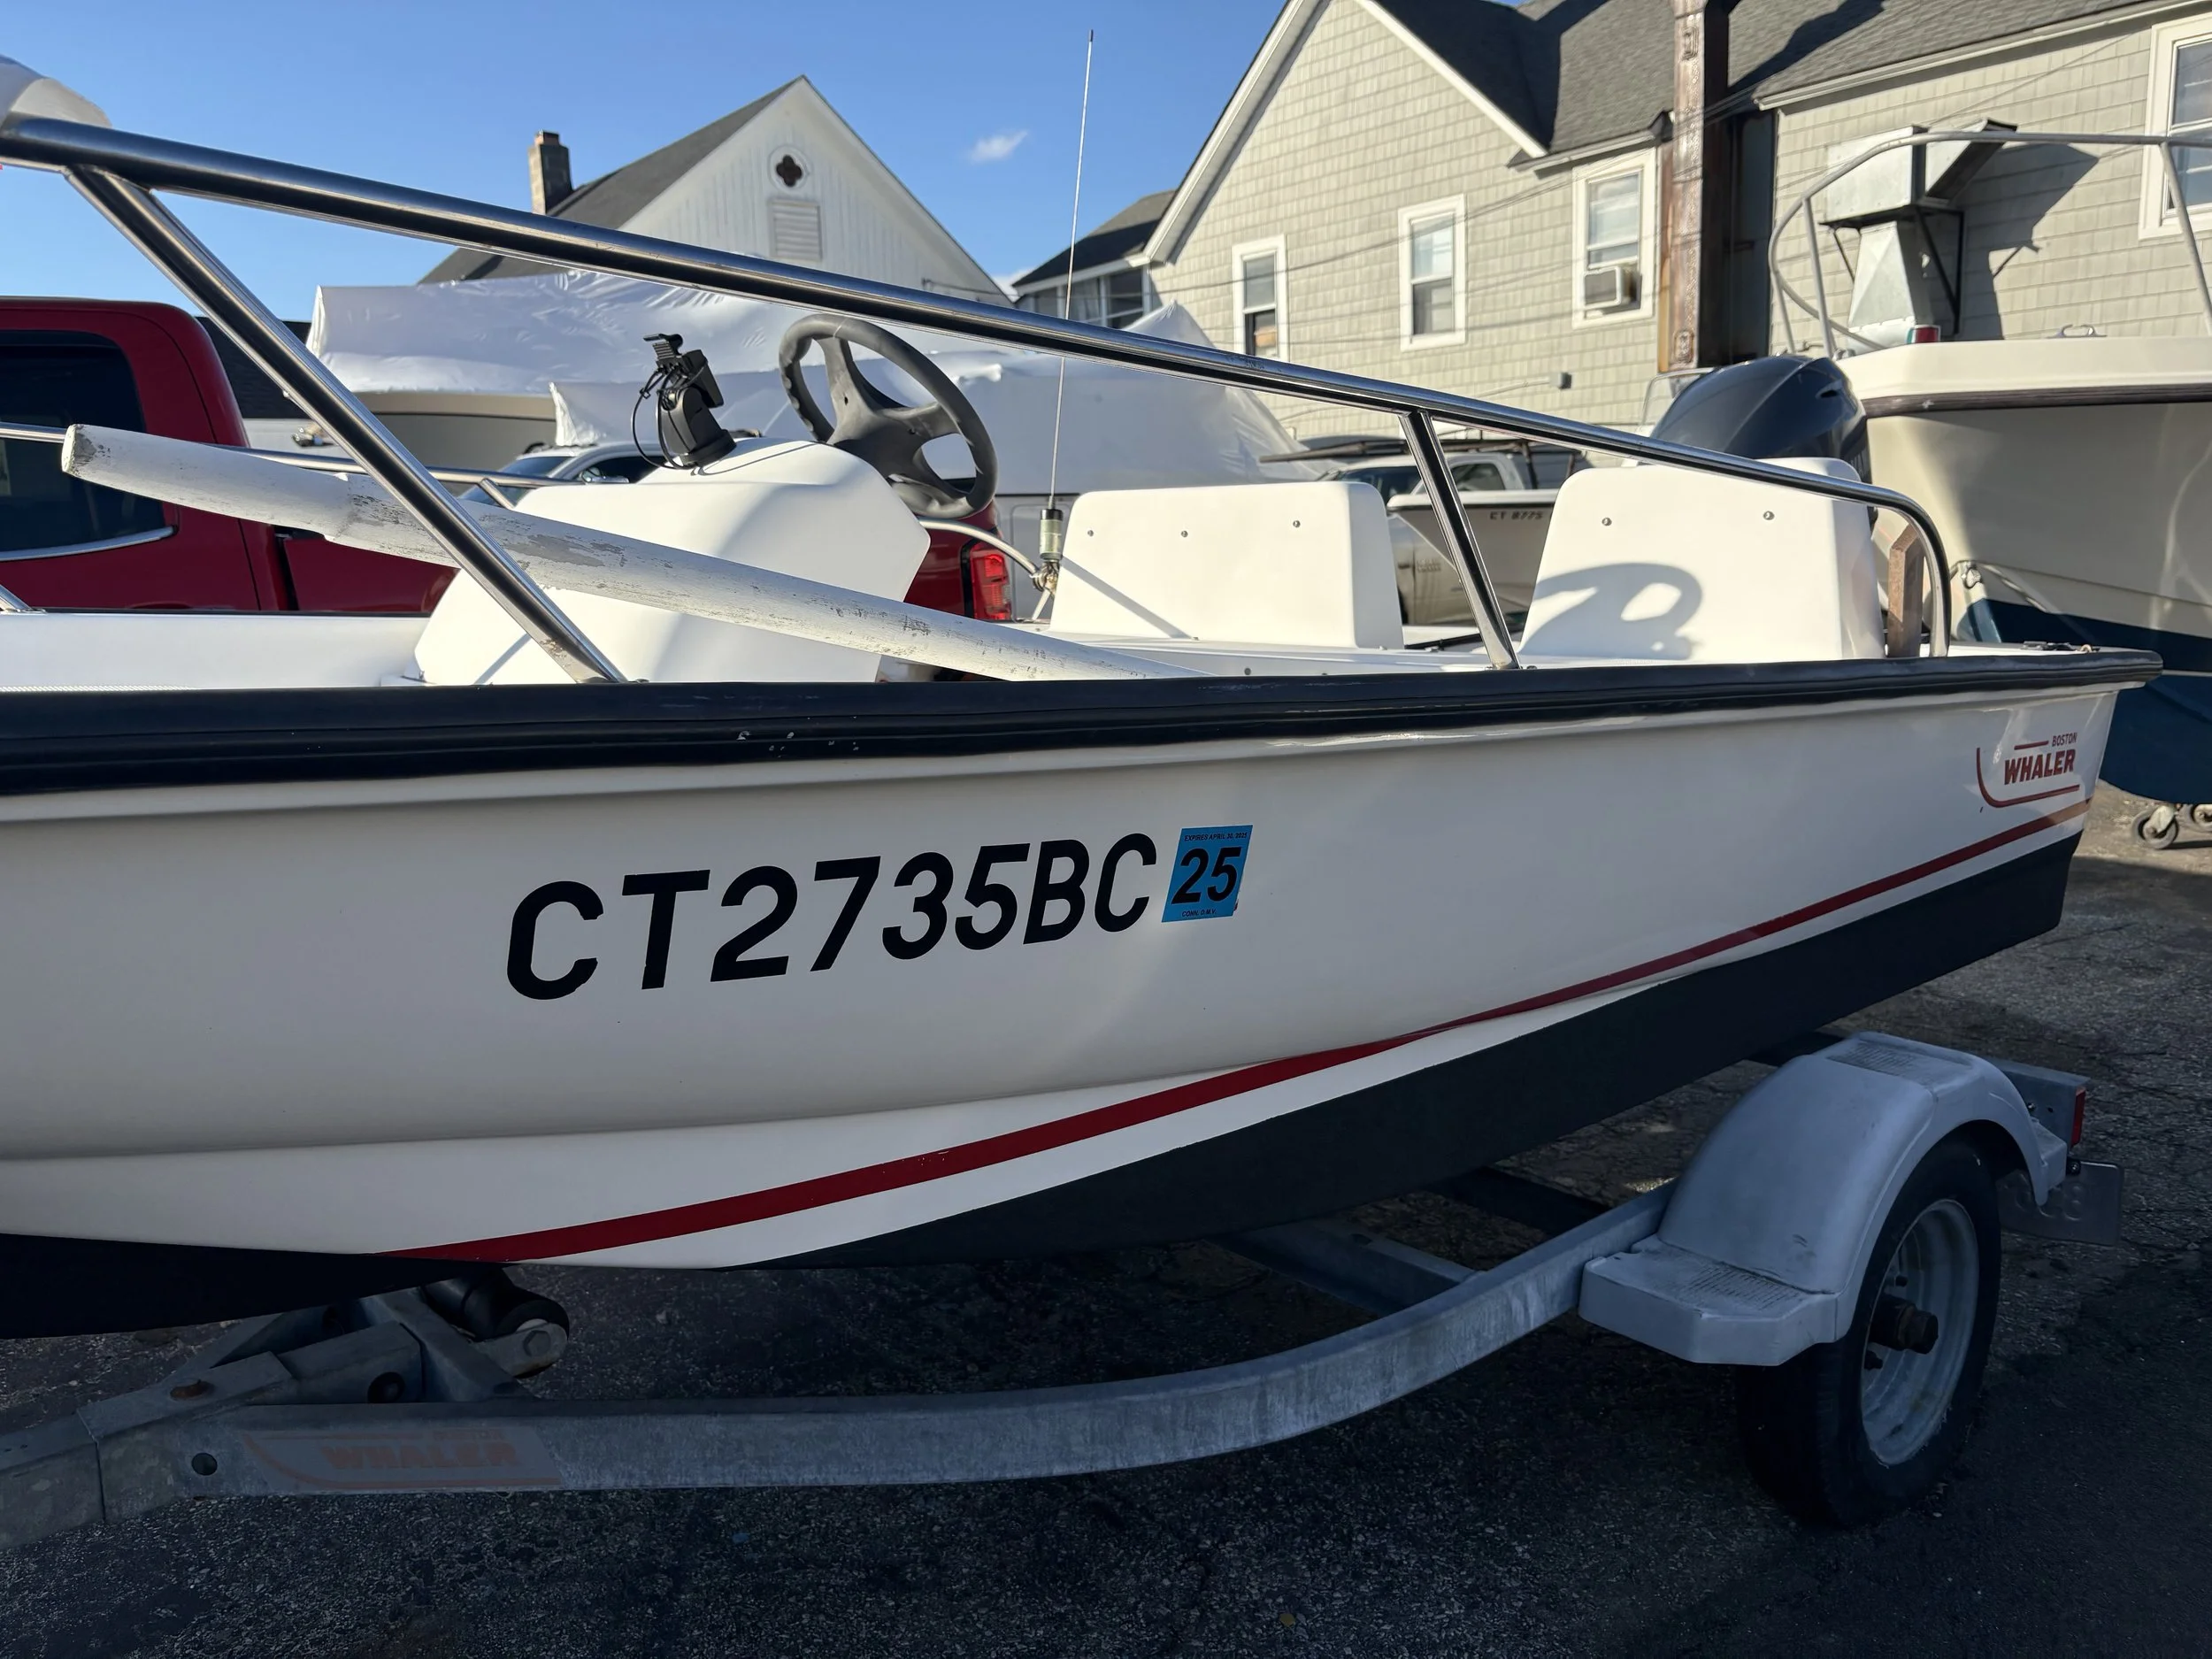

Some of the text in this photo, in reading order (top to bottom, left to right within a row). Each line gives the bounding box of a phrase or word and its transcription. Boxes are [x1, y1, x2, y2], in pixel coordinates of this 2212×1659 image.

[2052, 733, 2078, 748] BOSTON
[2004, 749, 2076, 786] WHALER
[1209, 832, 1225, 841] APRIL
[1171, 847, 1242, 904] 25
[507, 833, 1156, 1000] CT2735BC
[320, 1441, 522, 1470] WHALER
